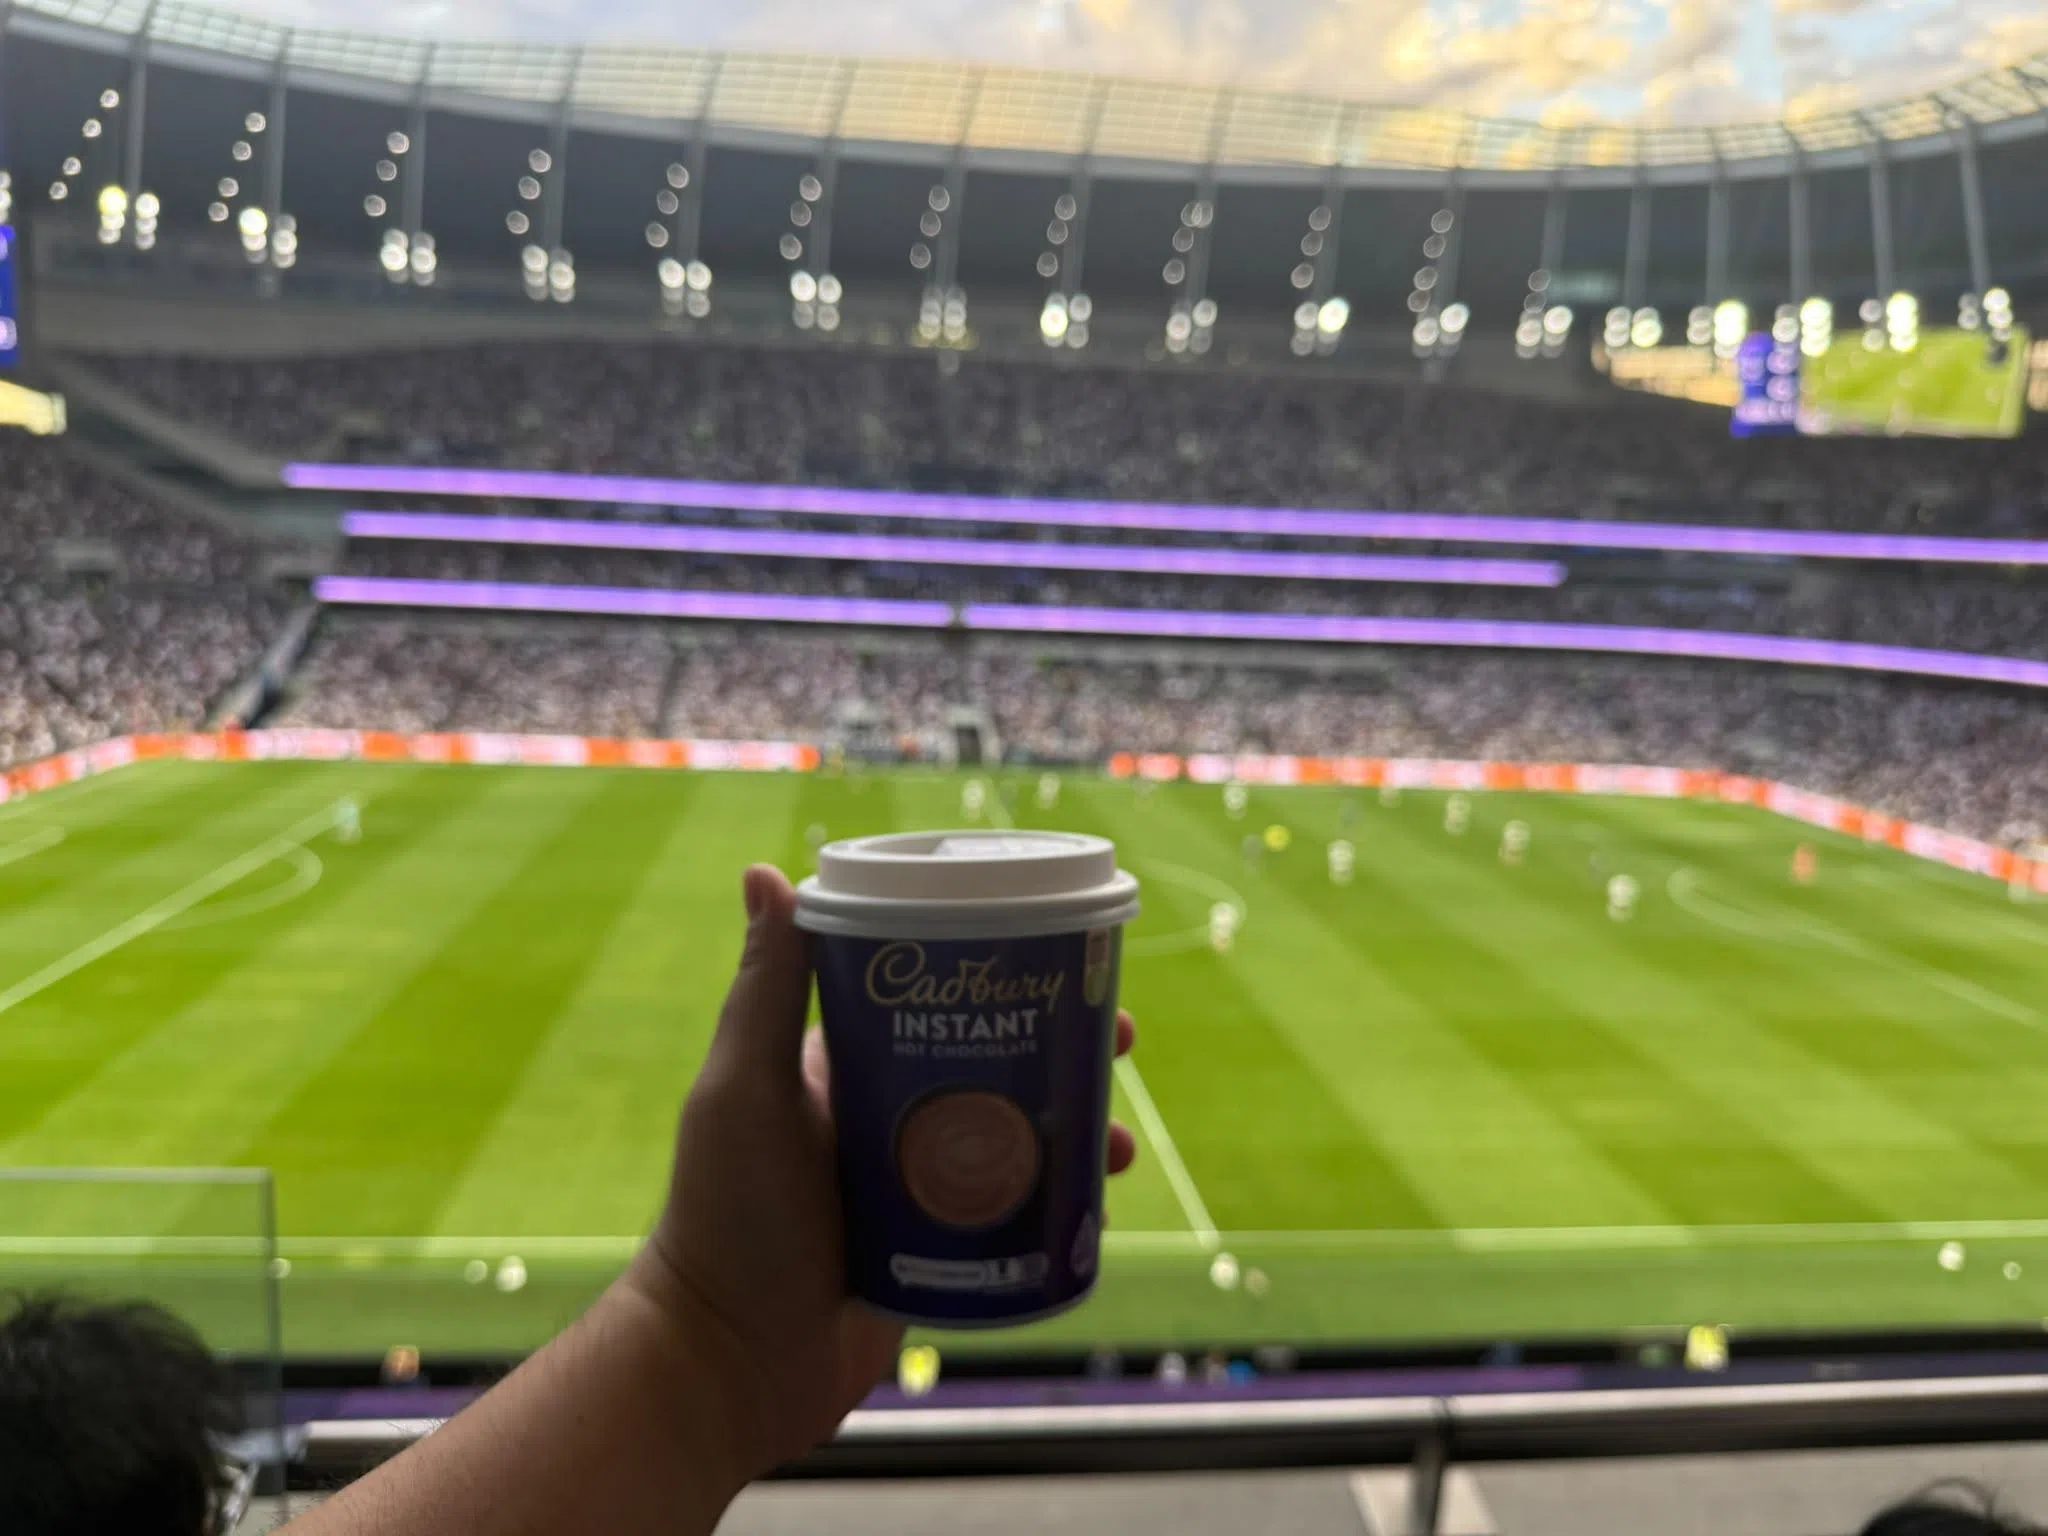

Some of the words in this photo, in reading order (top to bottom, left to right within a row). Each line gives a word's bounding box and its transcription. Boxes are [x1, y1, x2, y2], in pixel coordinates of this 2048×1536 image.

[866, 941, 1065, 1014] Cadbury
[893, 1008, 1038, 1040] INSTANT
[931, 1040, 1037, 1059] CHOCOLATE
